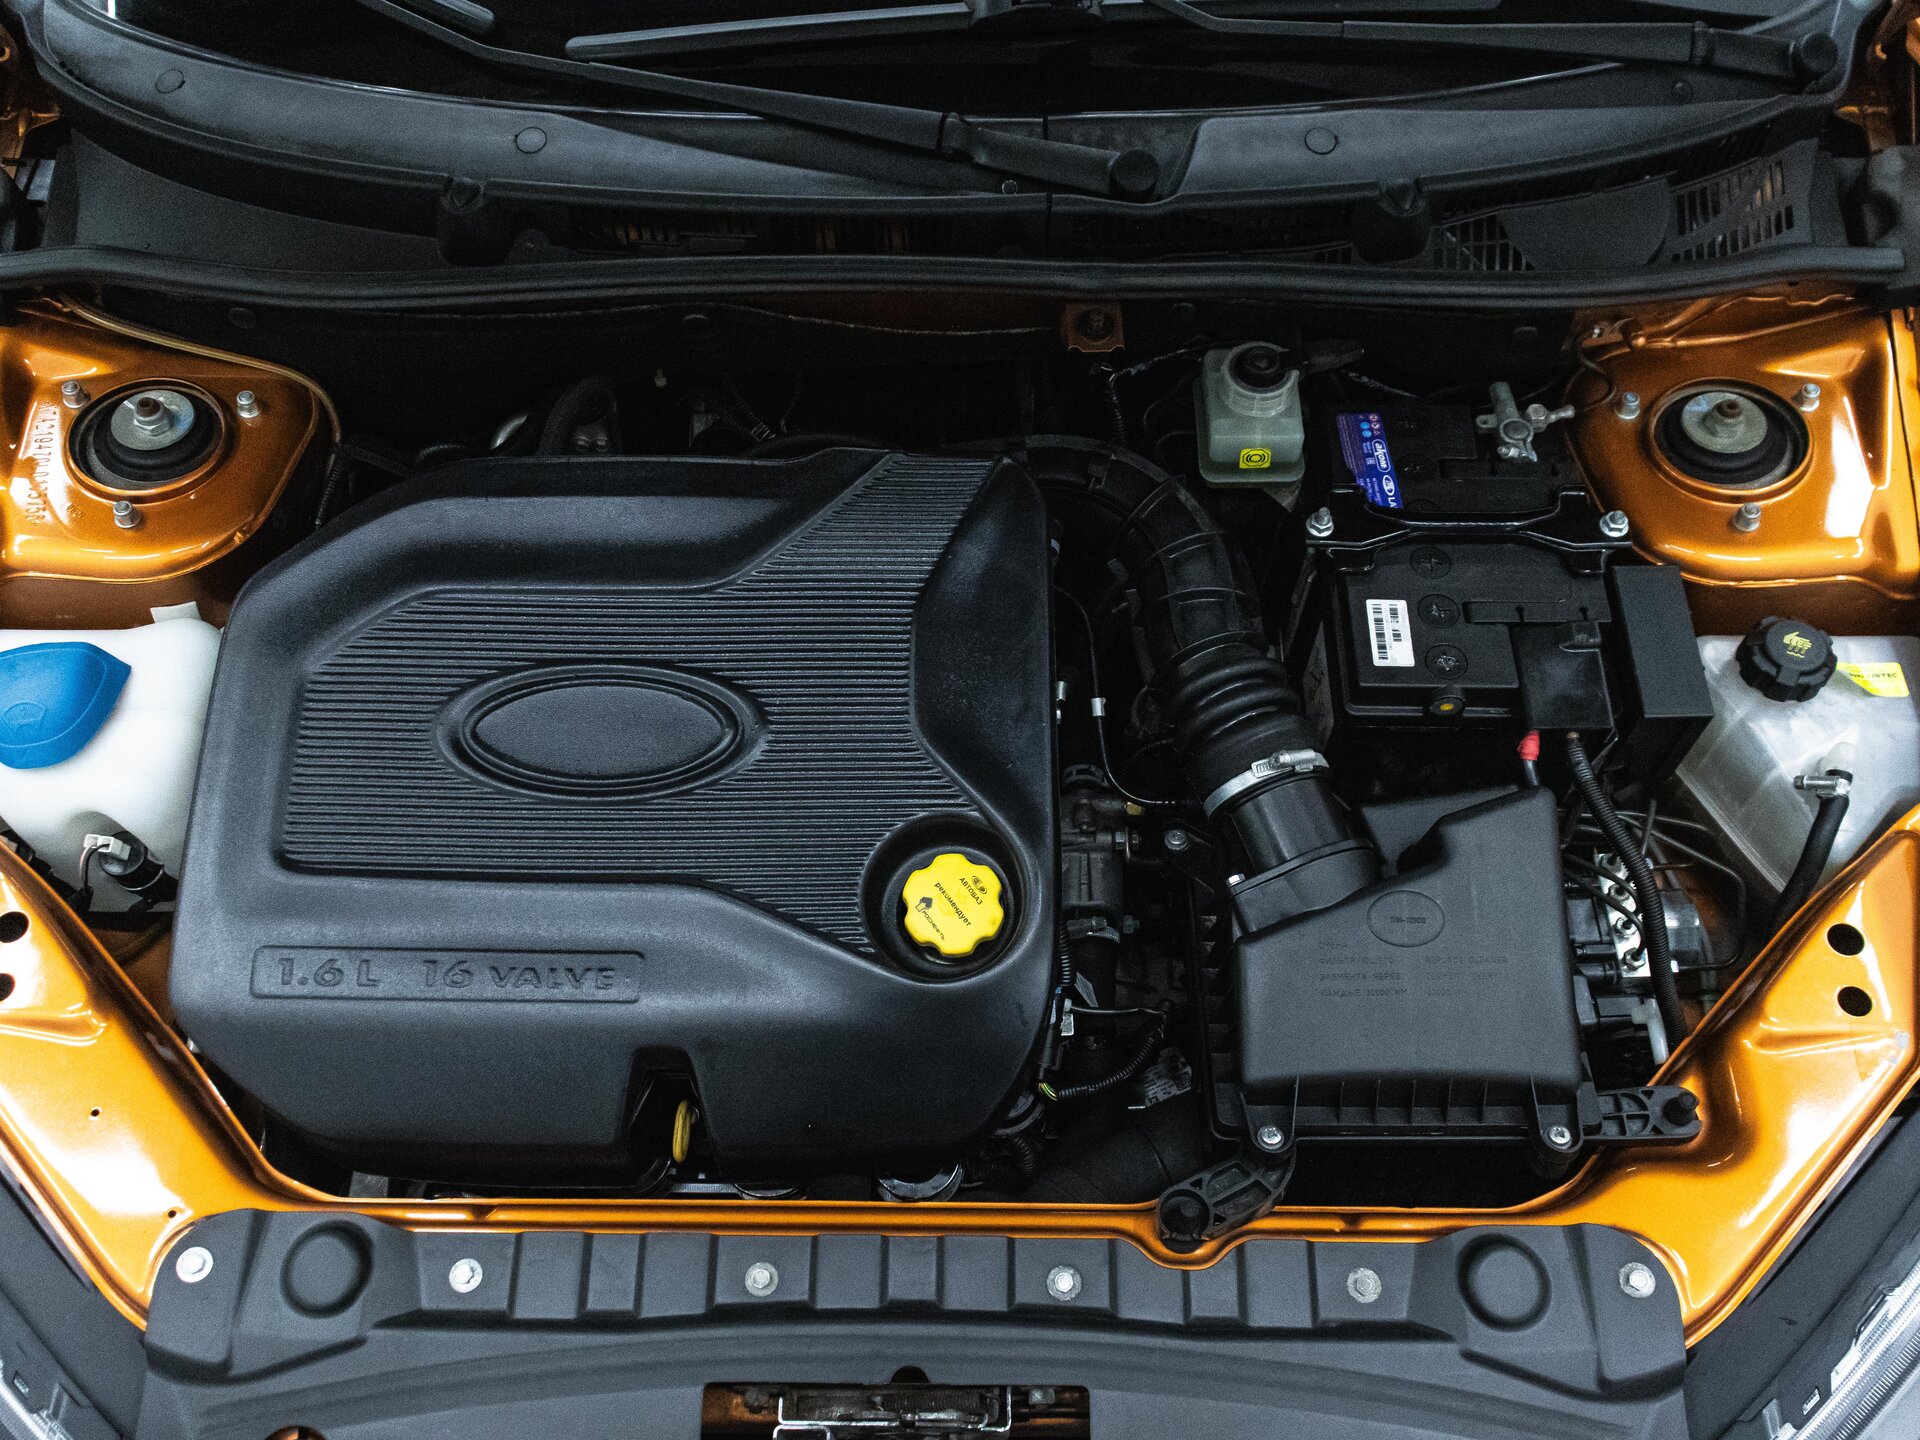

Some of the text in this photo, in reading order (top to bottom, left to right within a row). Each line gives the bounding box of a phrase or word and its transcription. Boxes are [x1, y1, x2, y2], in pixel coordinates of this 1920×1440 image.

[1387, 496, 1398, 508] LA
[934, 882, 971, 926] рекомендует
[959, 877, 983, 905] АВТОВАЗ
[921, 910, 945, 940] РОСНЕФТЬ
[278, 957, 616, 990] 1.6 L 16 VALVE
